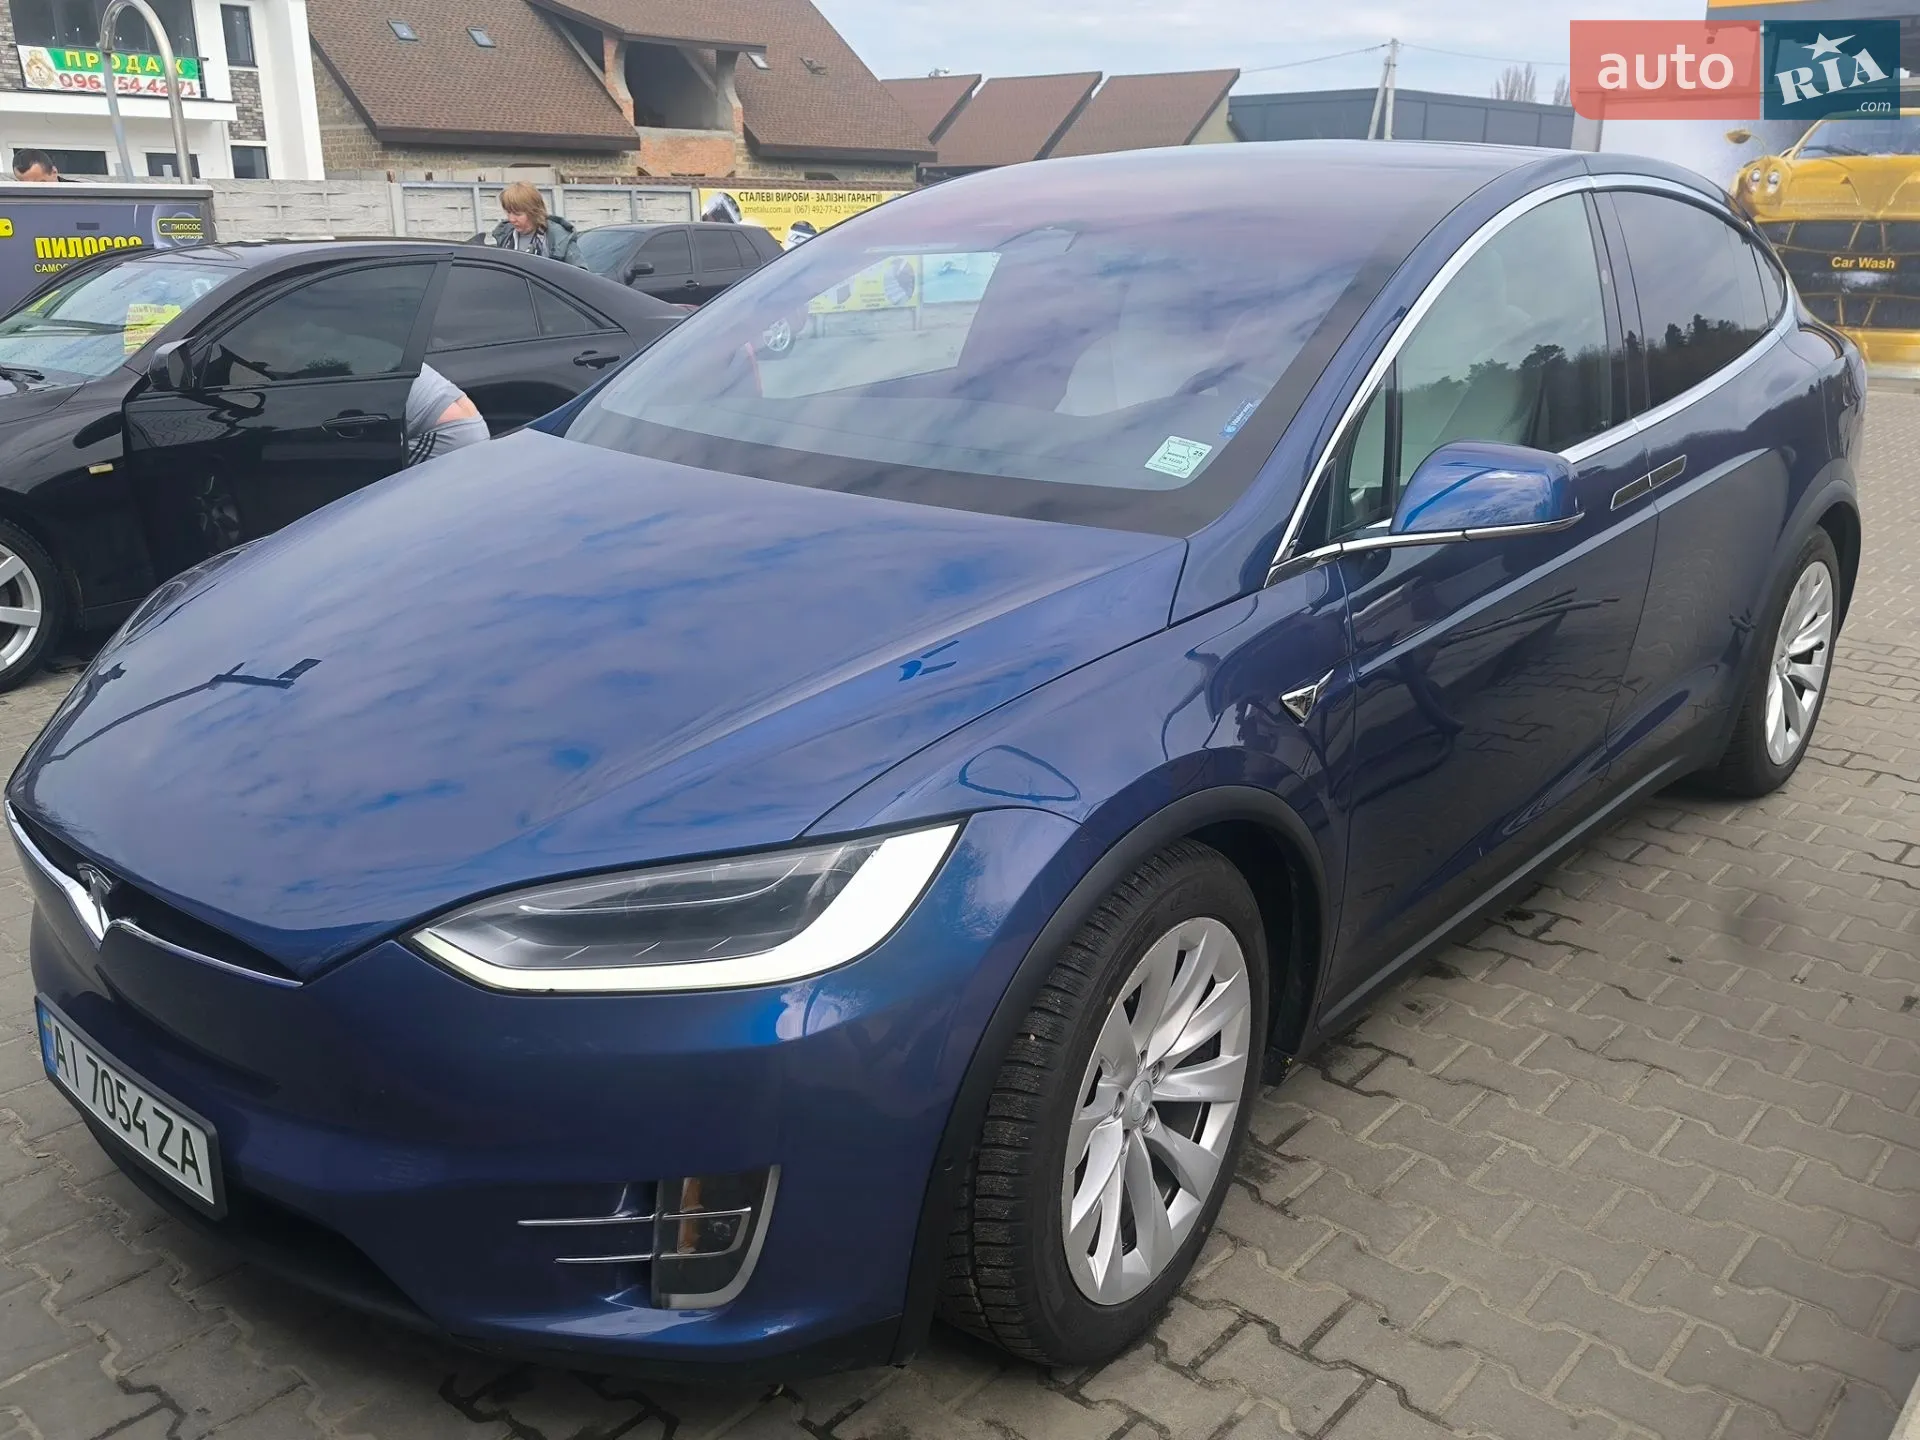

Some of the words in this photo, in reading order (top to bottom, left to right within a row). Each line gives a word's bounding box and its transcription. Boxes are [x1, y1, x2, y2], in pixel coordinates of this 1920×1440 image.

[738, 191, 774, 202] СТАЛЕВІ
[775, 191, 810, 203] ВИРОБИ
[815, 192, 846, 203] ЗАЛІЗНІ
[794, 205, 811, 215] (067)
[171, 223, 201, 231] ПИЛОСОС
[1831, 256, 1856, 268] Car
[1858, 257, 1896, 269] Wash
[54, 1025, 80, 1089] AI
[86, 1054, 150, 1149] 7054
[152, 1106, 204, 1187] ZA
